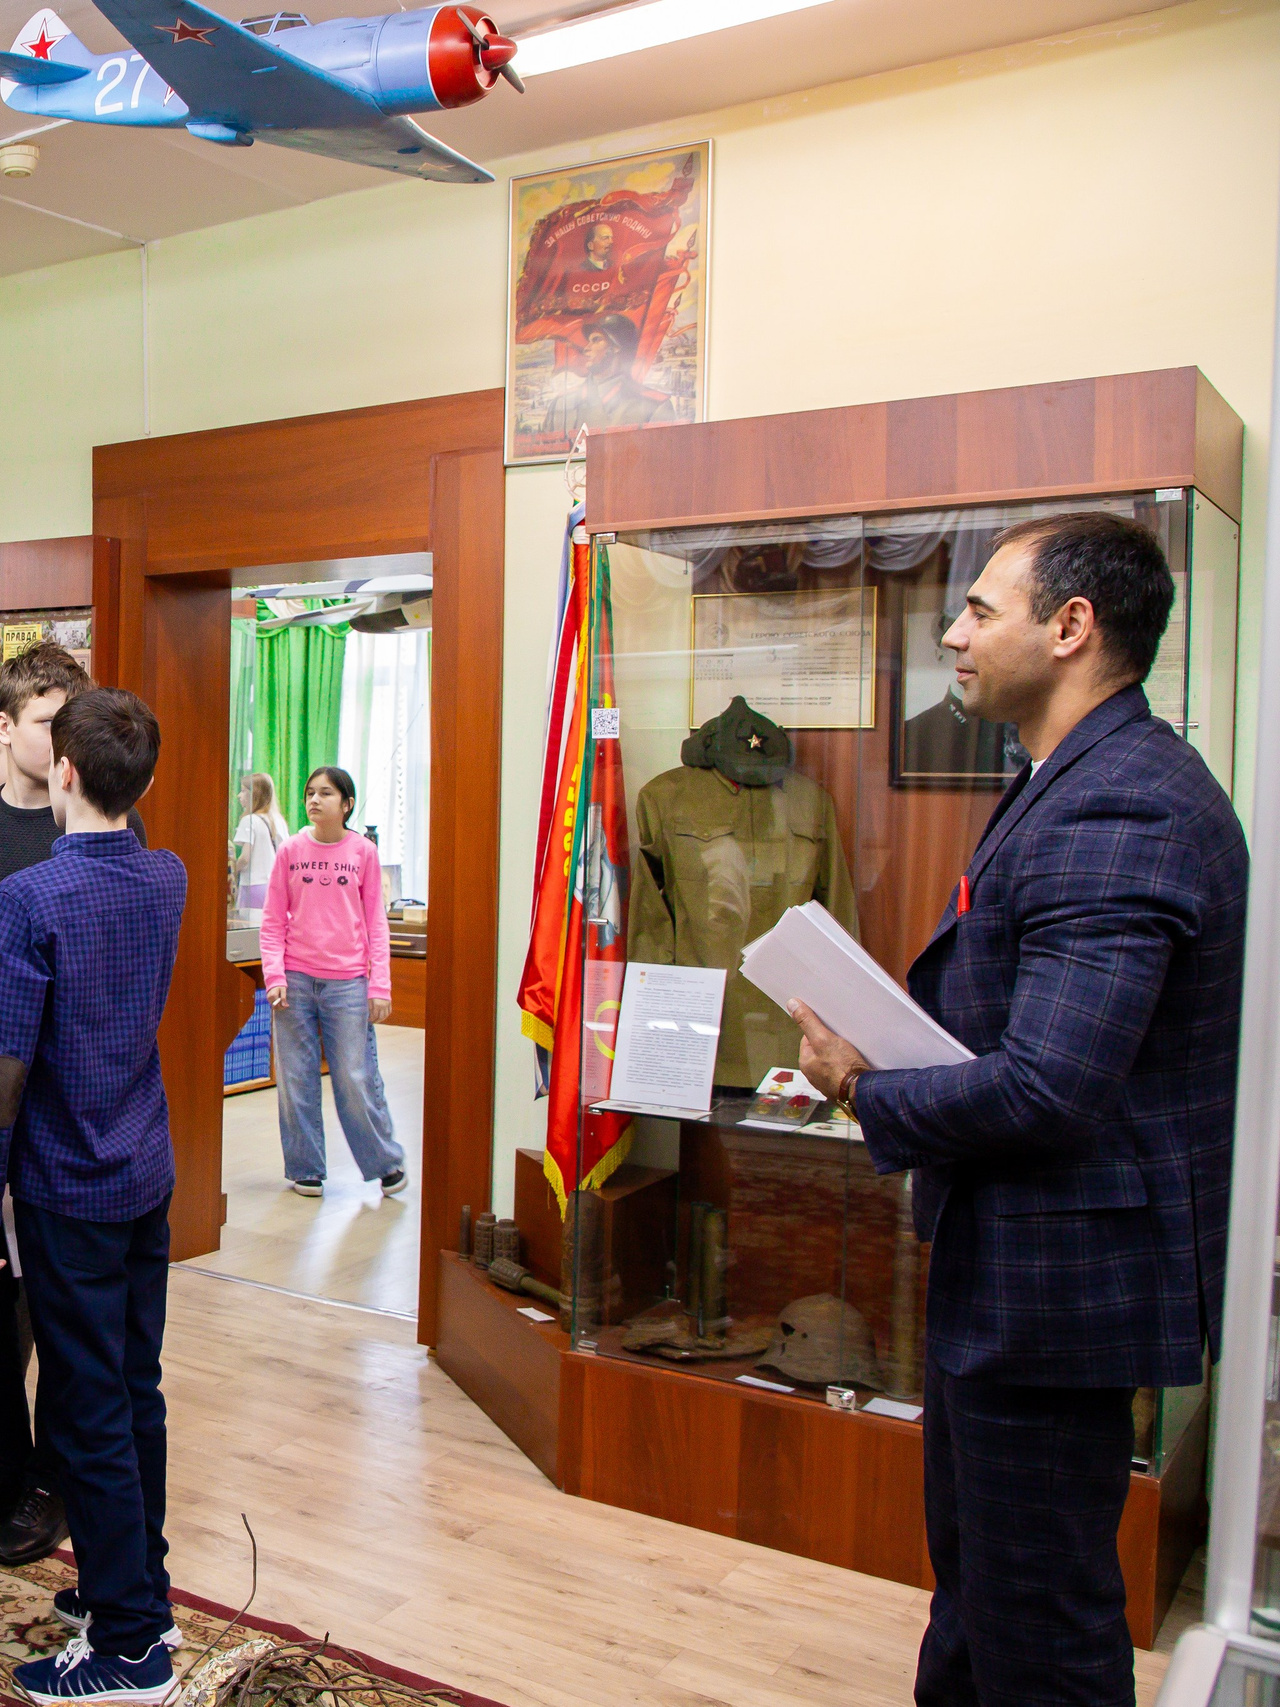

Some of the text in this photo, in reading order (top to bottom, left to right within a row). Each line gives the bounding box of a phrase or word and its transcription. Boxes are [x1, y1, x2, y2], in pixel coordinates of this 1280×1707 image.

[95, 54, 150, 116] 27
[622, 216, 652, 239] РОДИНУ
[572, 281, 610, 293] СССР
[6, 631, 37, 642] ПРАВДА
